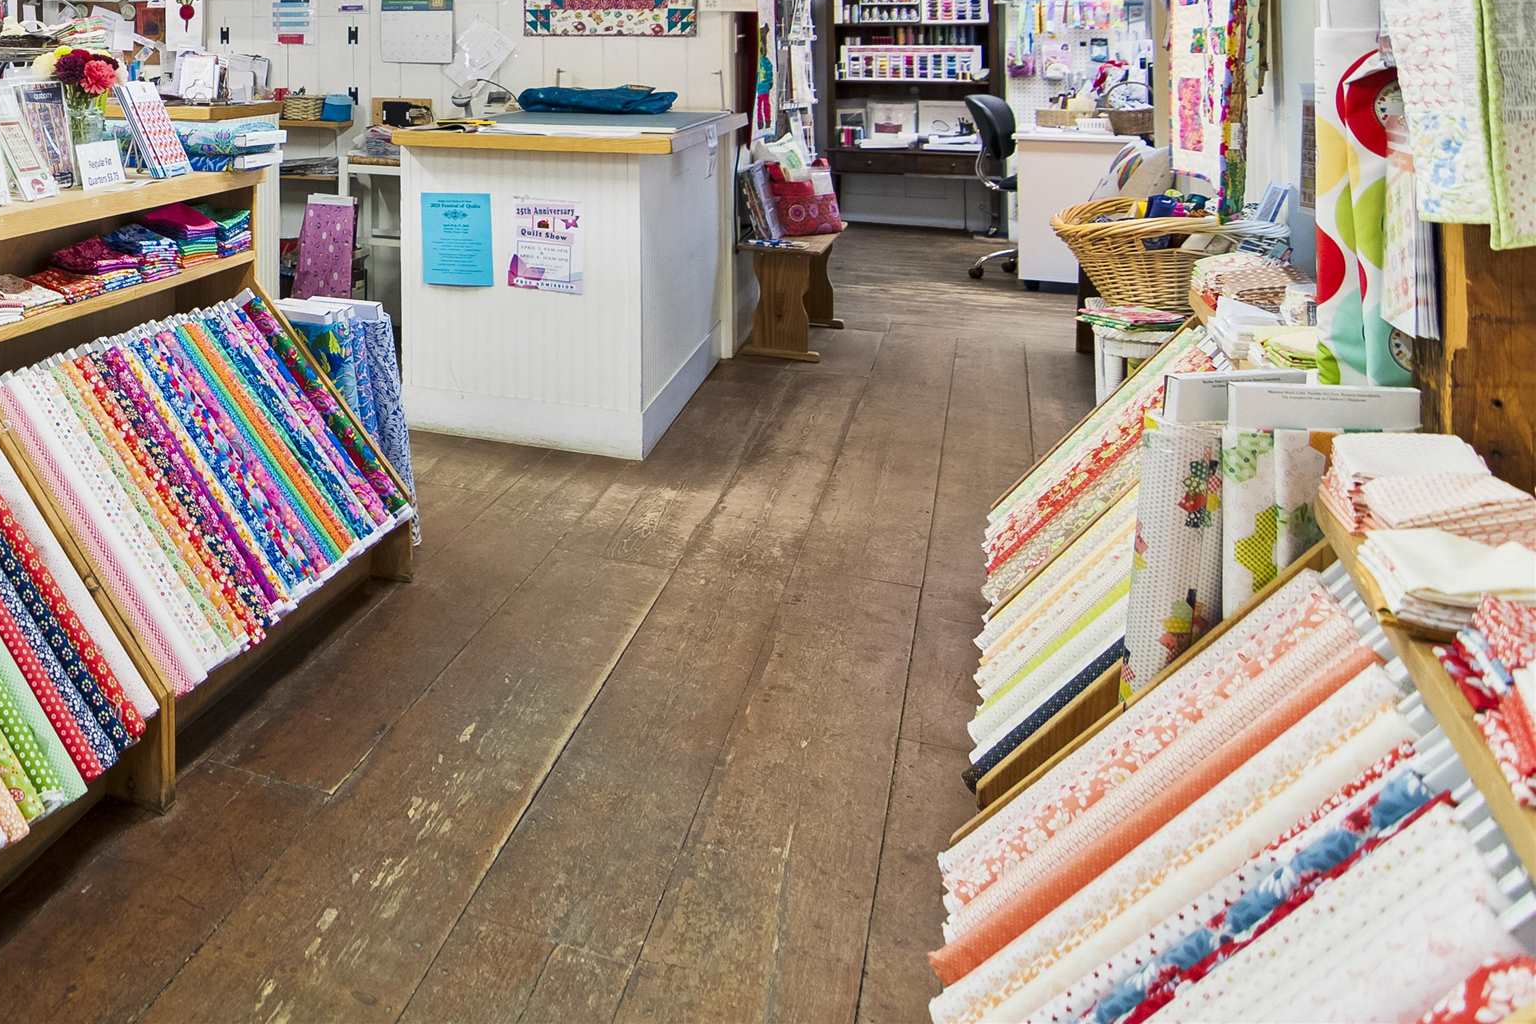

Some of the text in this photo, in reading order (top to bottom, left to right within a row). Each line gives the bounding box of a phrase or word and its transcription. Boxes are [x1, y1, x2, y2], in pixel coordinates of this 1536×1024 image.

[533, 207, 575, 216] Anniversary
[521, 228, 568, 241] Quilt Show
